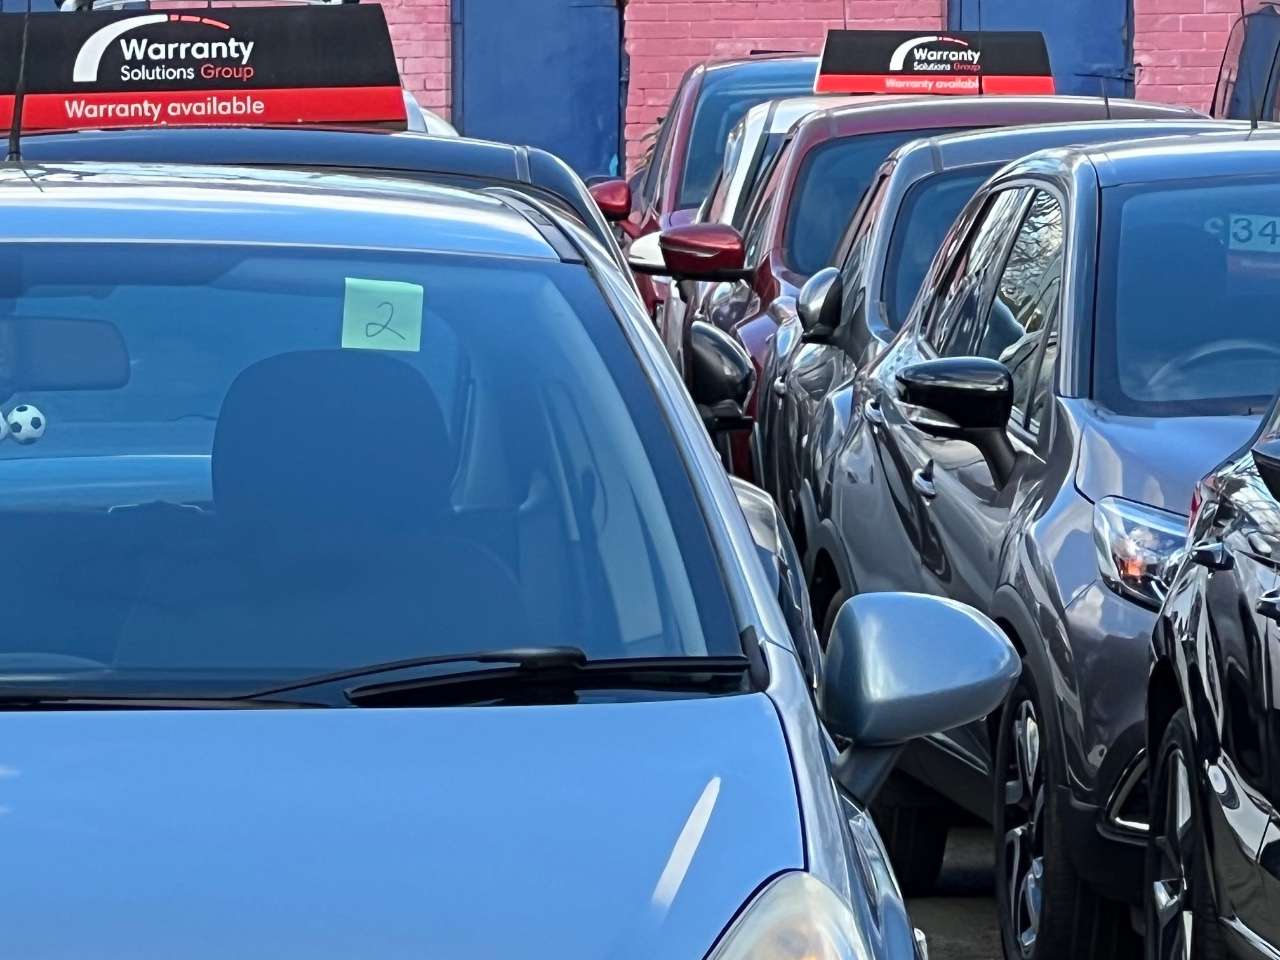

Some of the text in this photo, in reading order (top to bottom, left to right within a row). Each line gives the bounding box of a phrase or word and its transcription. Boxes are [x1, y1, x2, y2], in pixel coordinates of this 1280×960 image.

[120, 37, 254, 65] Warranty
[913, 48, 981, 63] Warranty
[120, 64, 254, 82] Solutions Group
[65, 96, 265, 120] Warranty available
[1232, 217, 1280, 245] 34
[365, 301, 406, 341] 2
